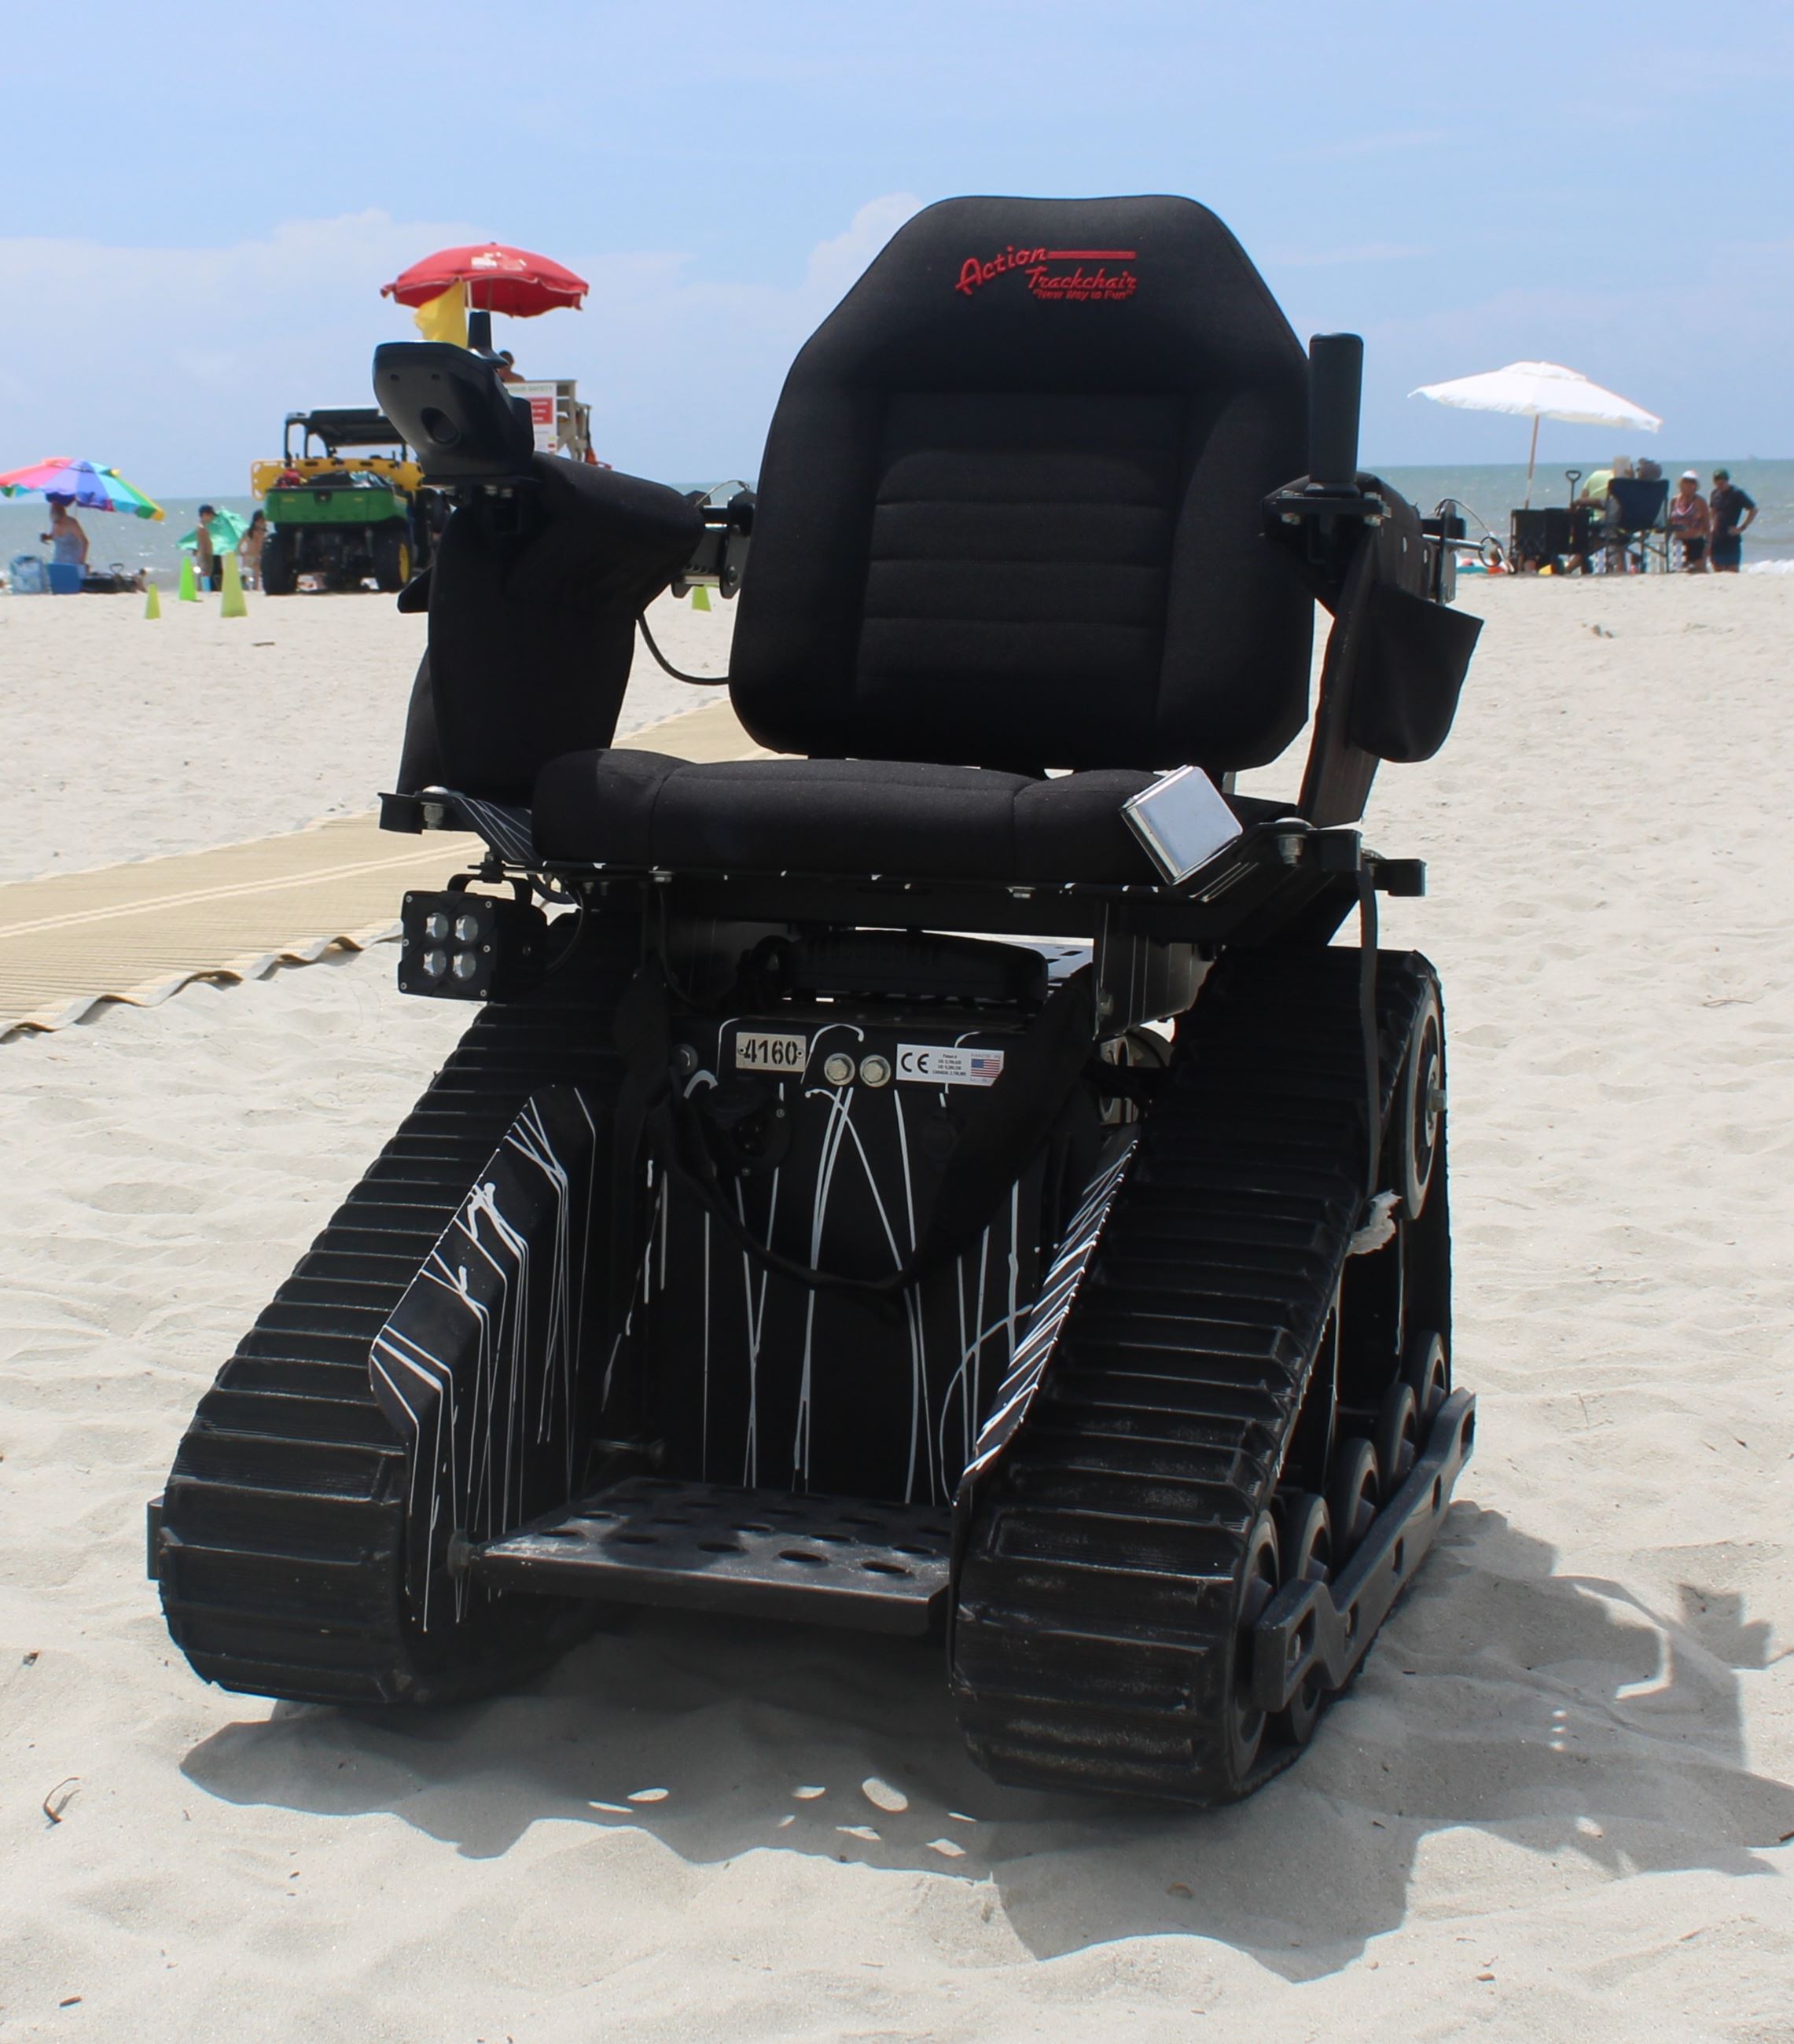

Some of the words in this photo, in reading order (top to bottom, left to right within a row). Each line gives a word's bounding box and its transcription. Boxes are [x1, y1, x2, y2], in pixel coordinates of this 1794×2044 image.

[956, 244, 1047, 295] Action
[1025, 265, 1138, 289] Trackchair
[1090, 290, 1102, 300] to
[743, 1038, 799, 1066] 4160
[901, 1052, 929, 1074] CE
